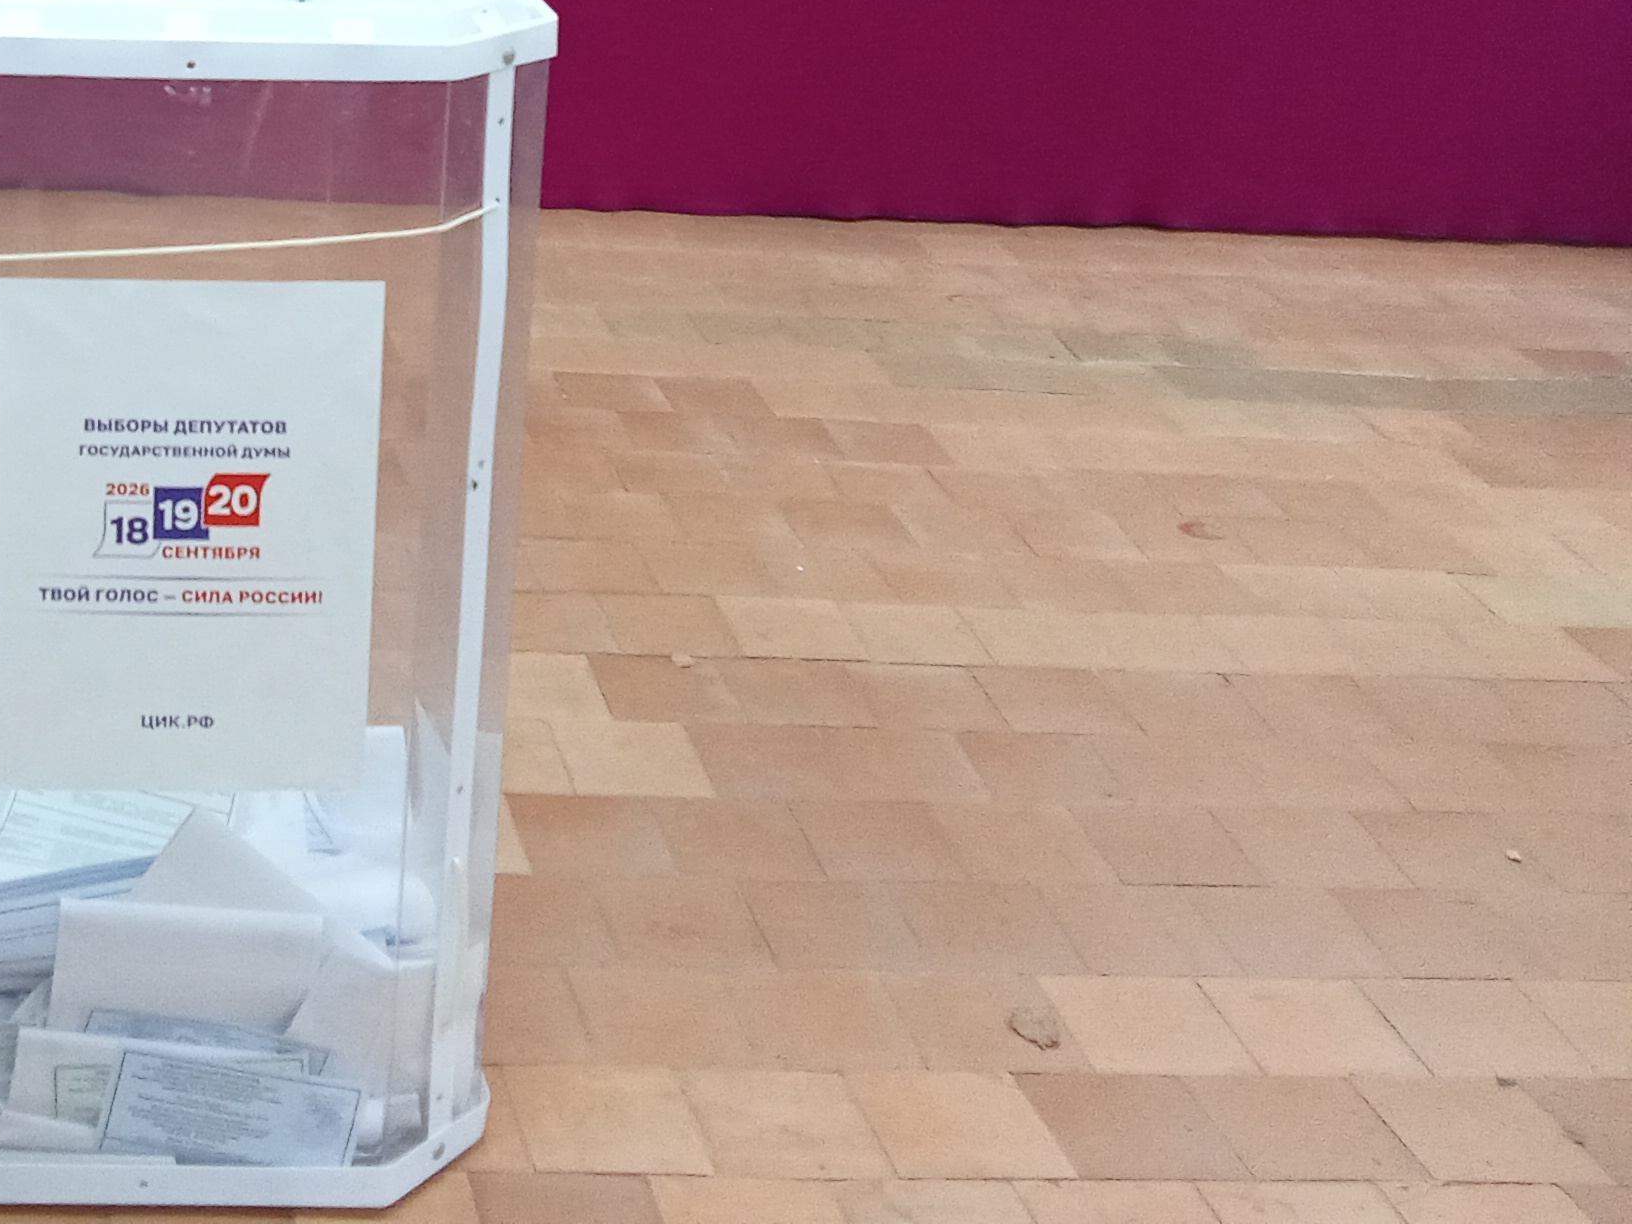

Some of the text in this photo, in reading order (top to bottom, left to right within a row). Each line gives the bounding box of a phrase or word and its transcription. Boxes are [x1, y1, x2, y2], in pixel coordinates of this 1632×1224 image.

[83, 418, 287, 436] ВЫБОРЫ ДЕПУТАТОВ
[79, 443, 291, 460] ГОСУДАРСТВЕННОЙ ДУМЫ
[105, 482, 150, 496] 2026
[110, 484, 258, 544] 18 19 20
[162, 545, 261, 560] СЕНТЯБРЯ
[39, 585, 90, 602] ТВОЙ
[95, 587, 159, 604] ГОЛОС
[181, 589, 234, 604] СИЛА
[238, 589, 324, 605] РОССИИ!
[141, 714, 214, 730] ЦИК.РФ
